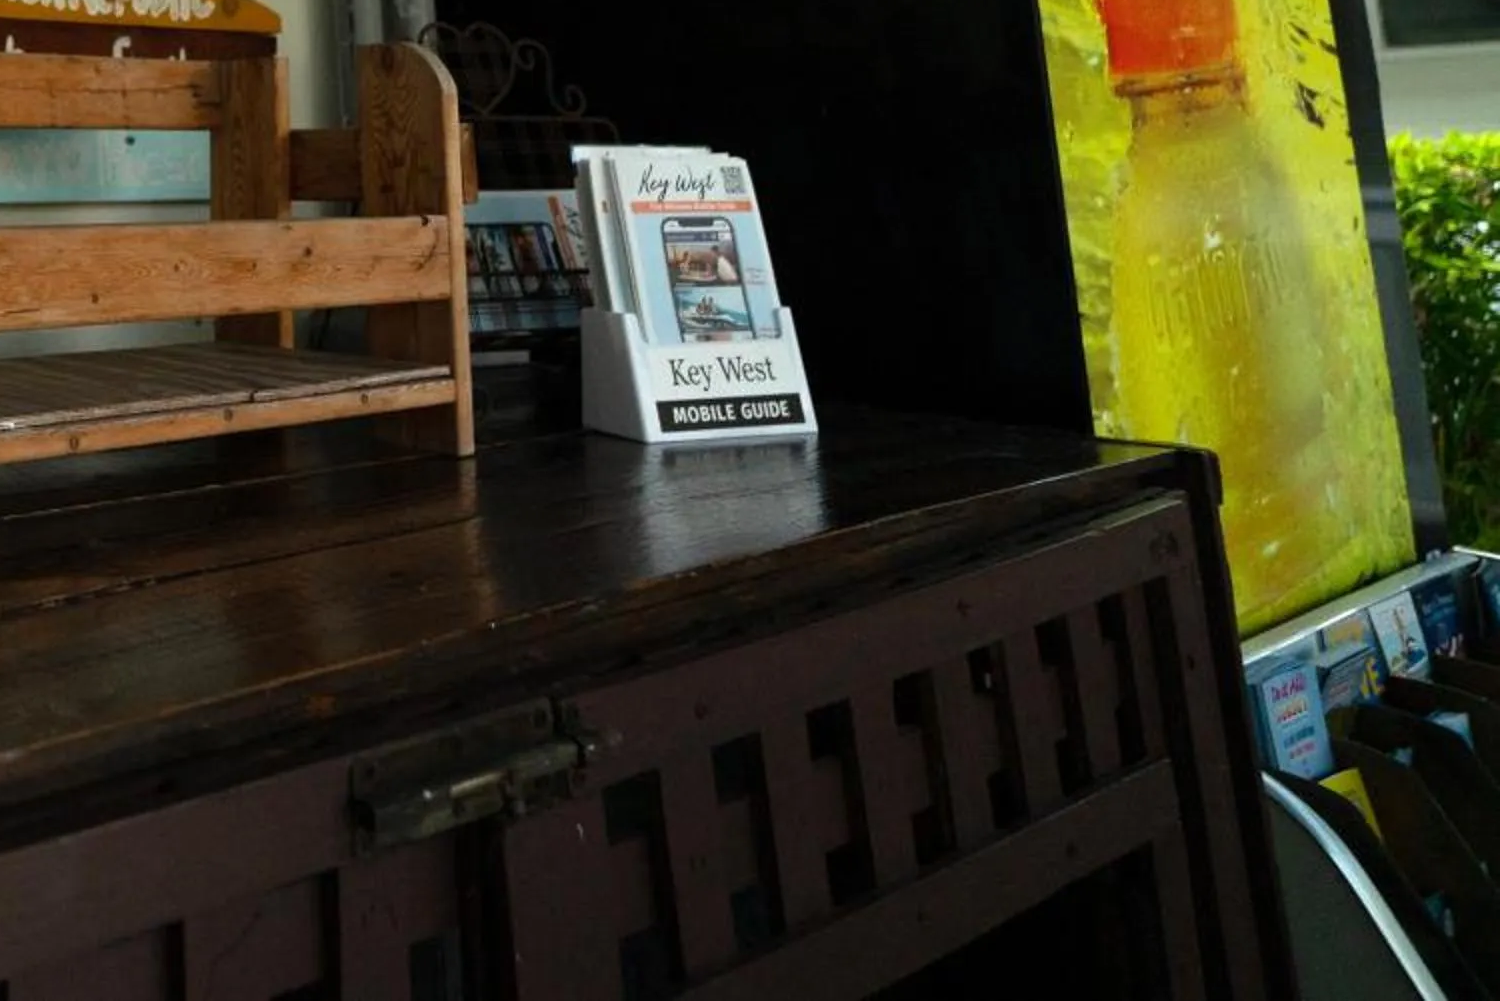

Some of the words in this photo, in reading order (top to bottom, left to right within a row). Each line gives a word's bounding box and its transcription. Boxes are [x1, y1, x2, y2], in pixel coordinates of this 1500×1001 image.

[638, 163, 669, 203] Key
[668, 358, 713, 392] Key
[716, 355, 777, 383] West
[673, 403, 737, 424] MOBILE
[741, 400, 791, 420] GUIDE
